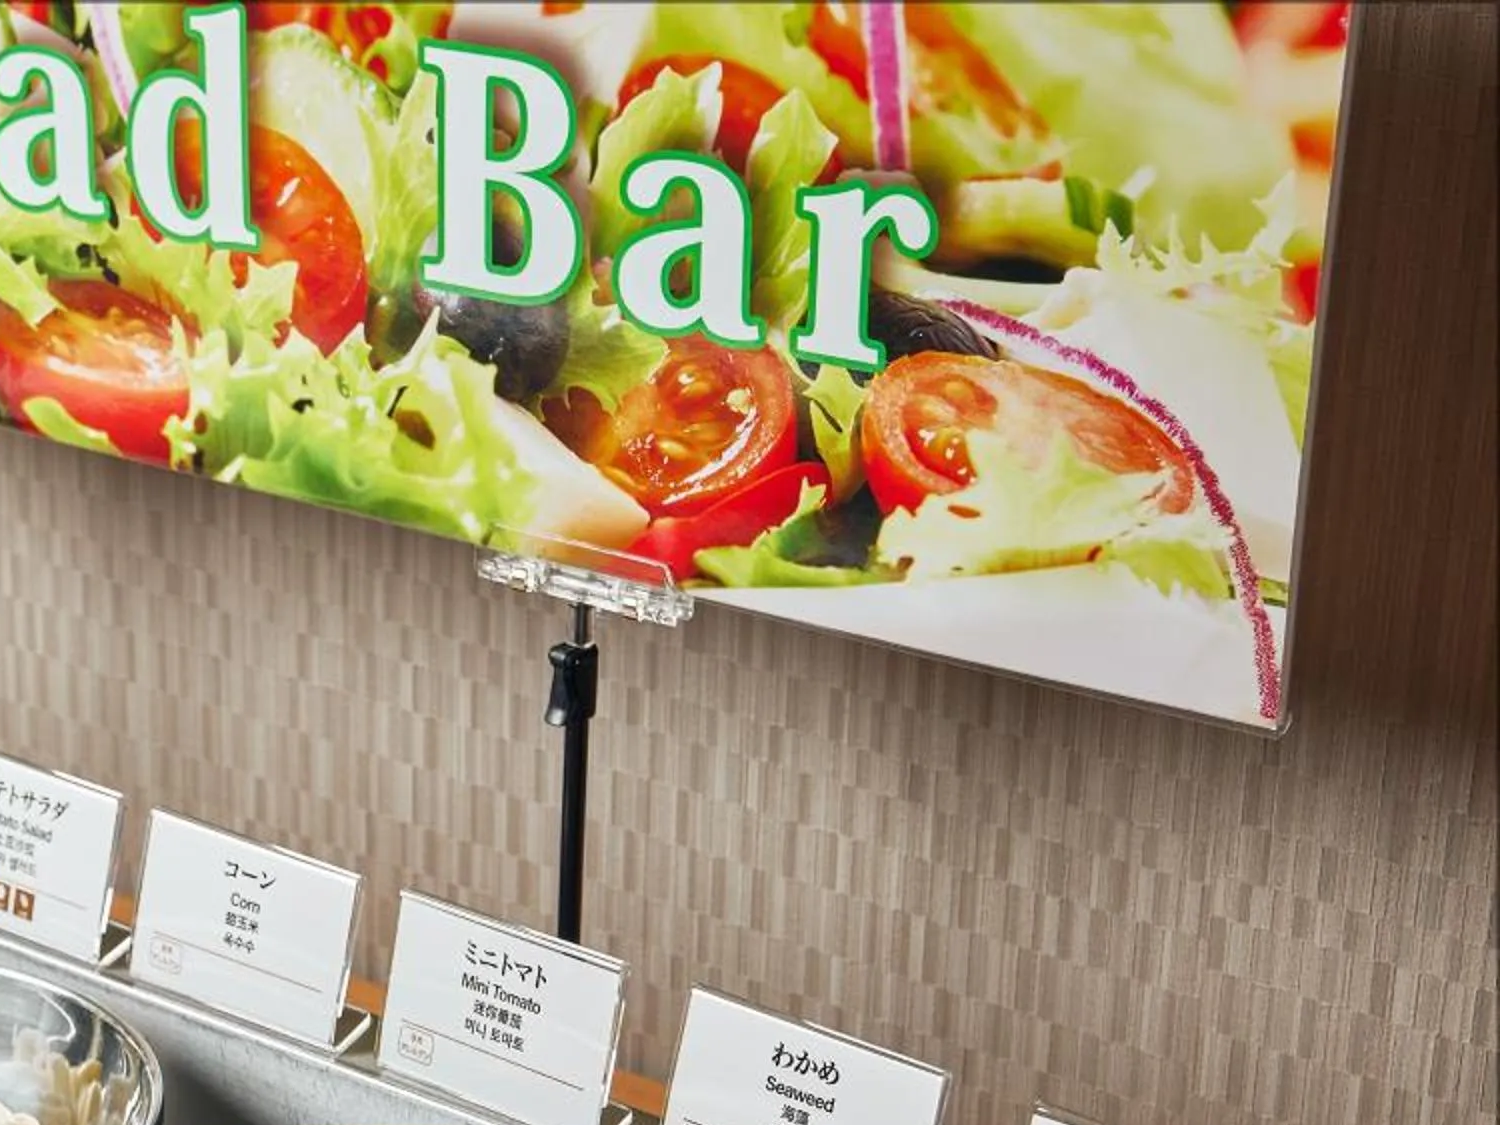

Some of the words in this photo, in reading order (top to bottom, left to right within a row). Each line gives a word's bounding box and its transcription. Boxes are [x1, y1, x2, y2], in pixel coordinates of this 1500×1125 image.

[420, 40, 937, 372] Bar
[224, 860, 277, 890] コーン
[230, 892, 261, 915] Corn
[463, 938, 548, 989] ミニトマト
[460, 972, 491, 996] Mini
[493, 983, 541, 1015] Tomato
[770, 1041, 840, 1086] わかめ
[764, 1075, 836, 1115] Seaweed
